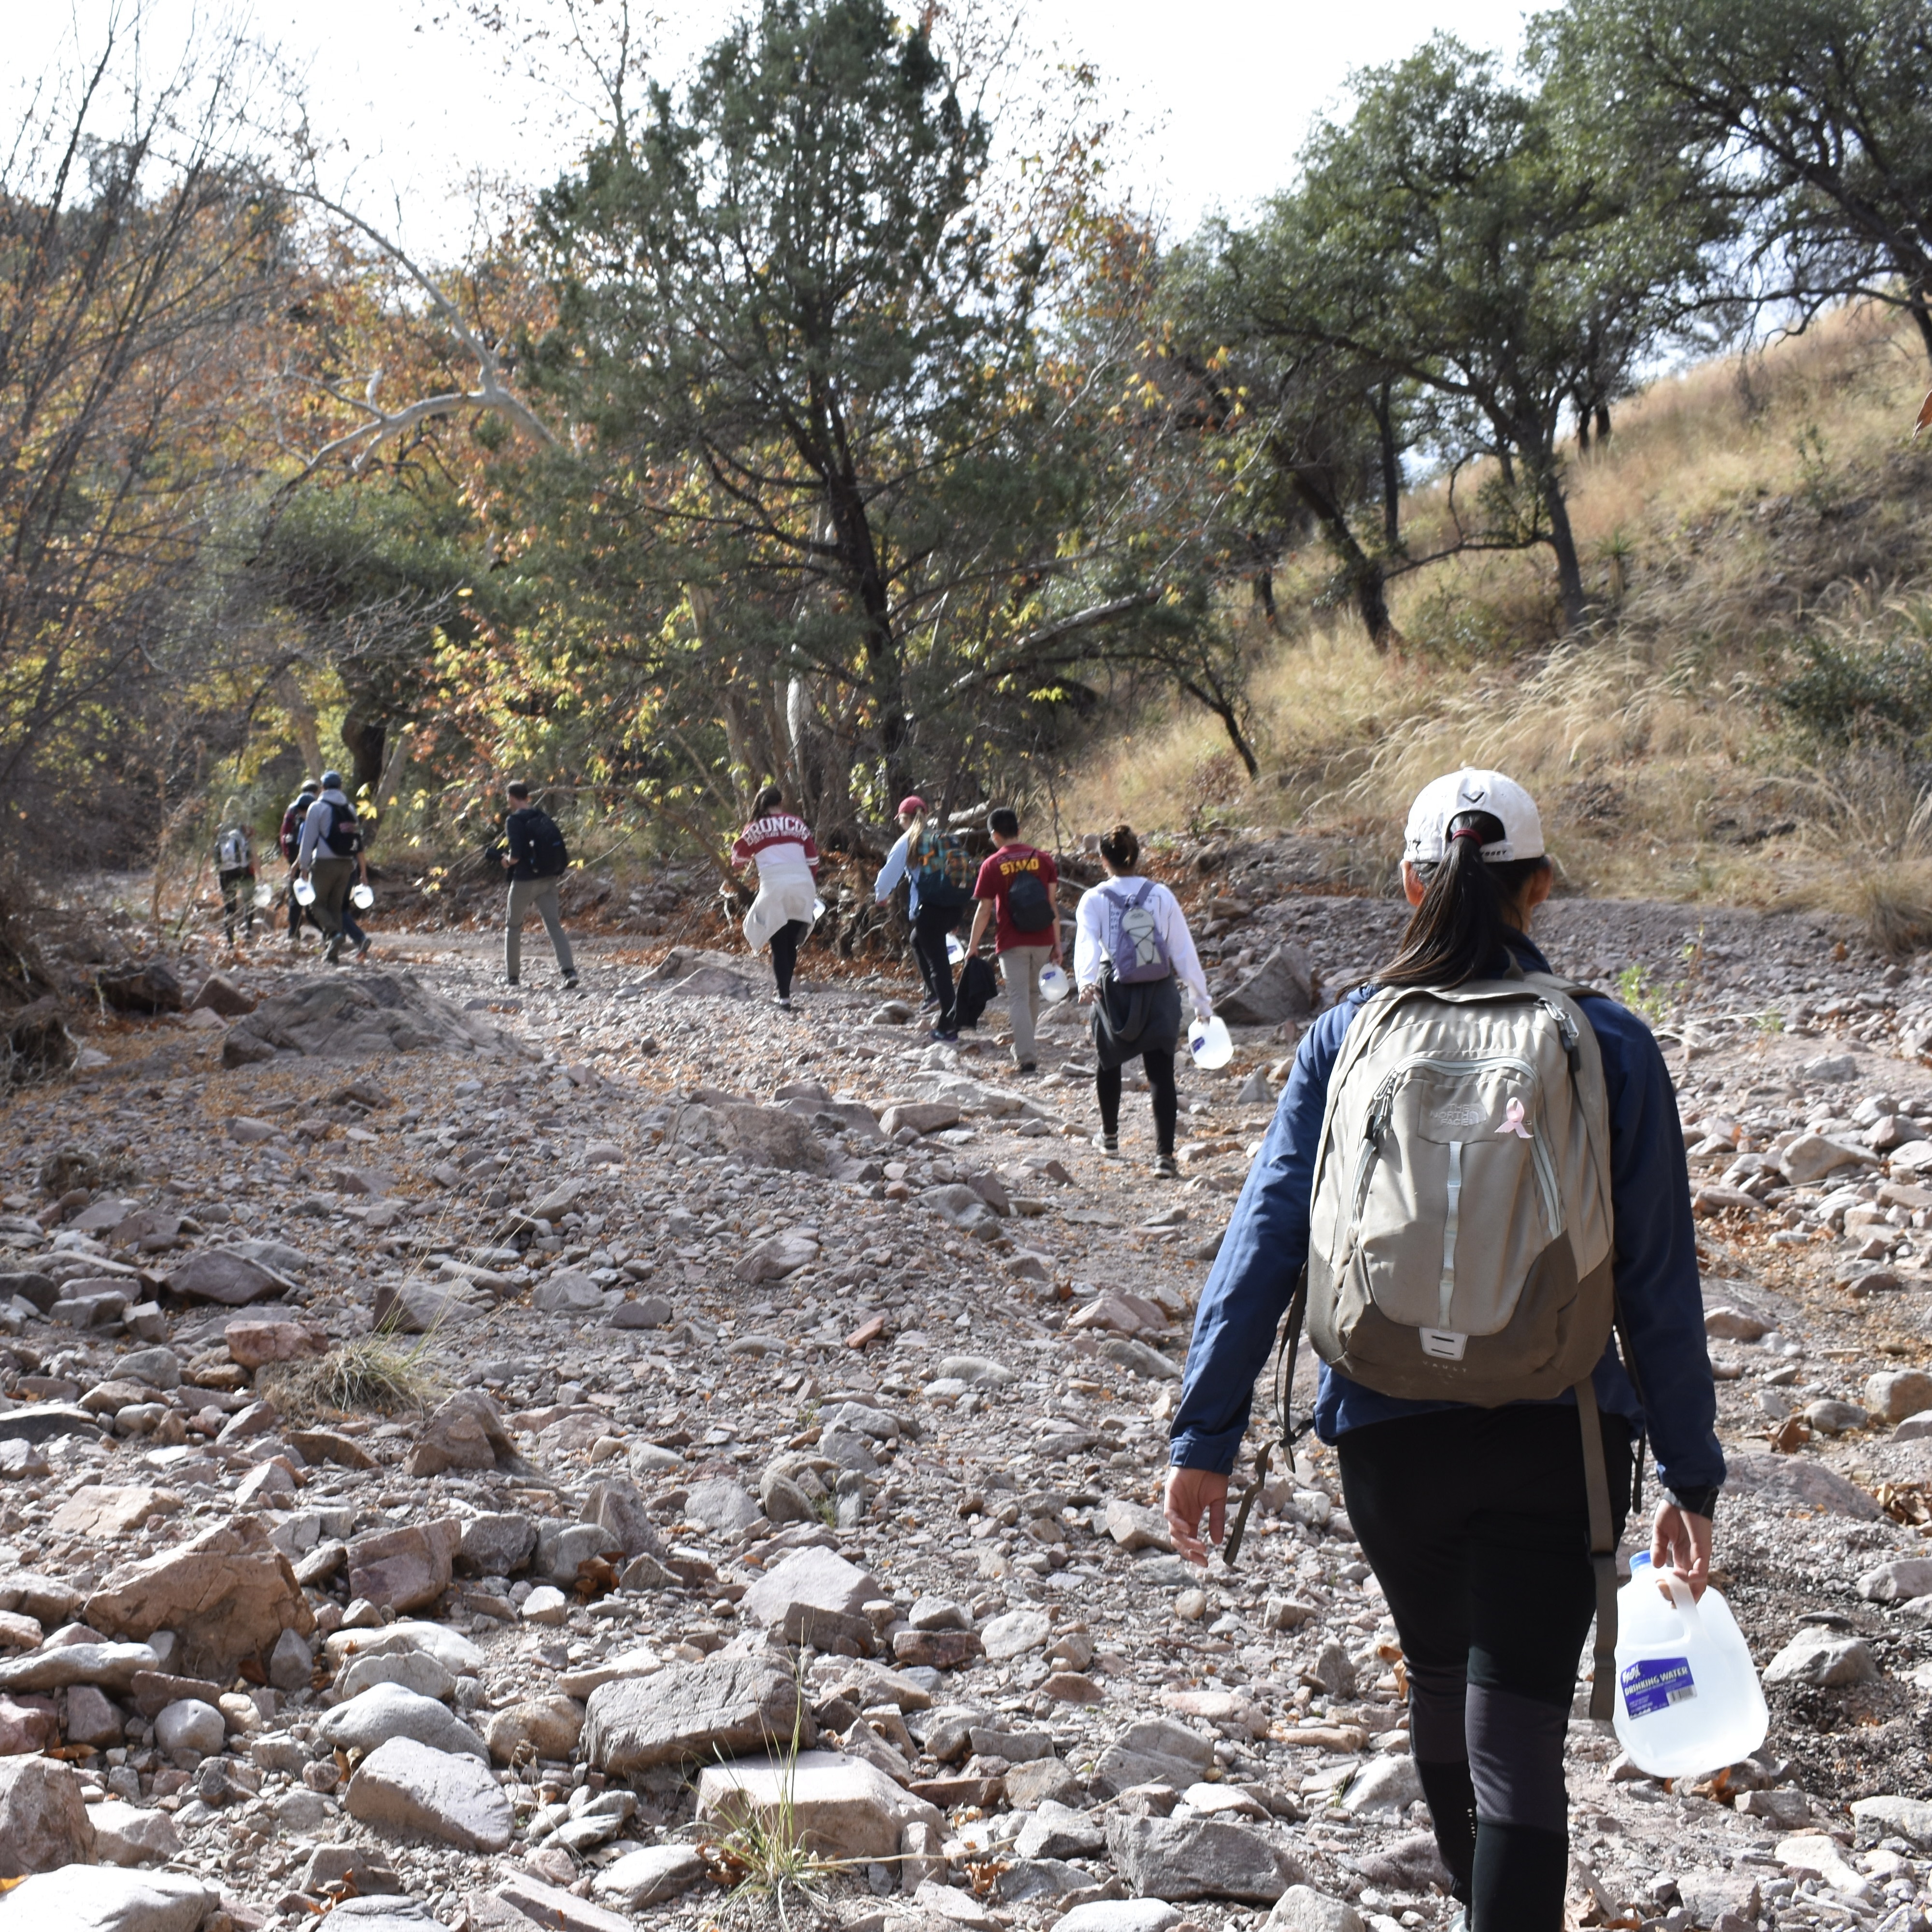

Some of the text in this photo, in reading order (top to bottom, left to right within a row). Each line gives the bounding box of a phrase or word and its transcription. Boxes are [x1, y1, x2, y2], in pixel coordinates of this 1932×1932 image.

[743, 816, 811, 846] BRONCOS
[1430, 1110, 1469, 1119] NORTH
[1448, 1103, 1470, 1112] THE
[1625, 1676, 1659, 1696] DRINKING
[1660, 1666, 1688, 1681] WATER
